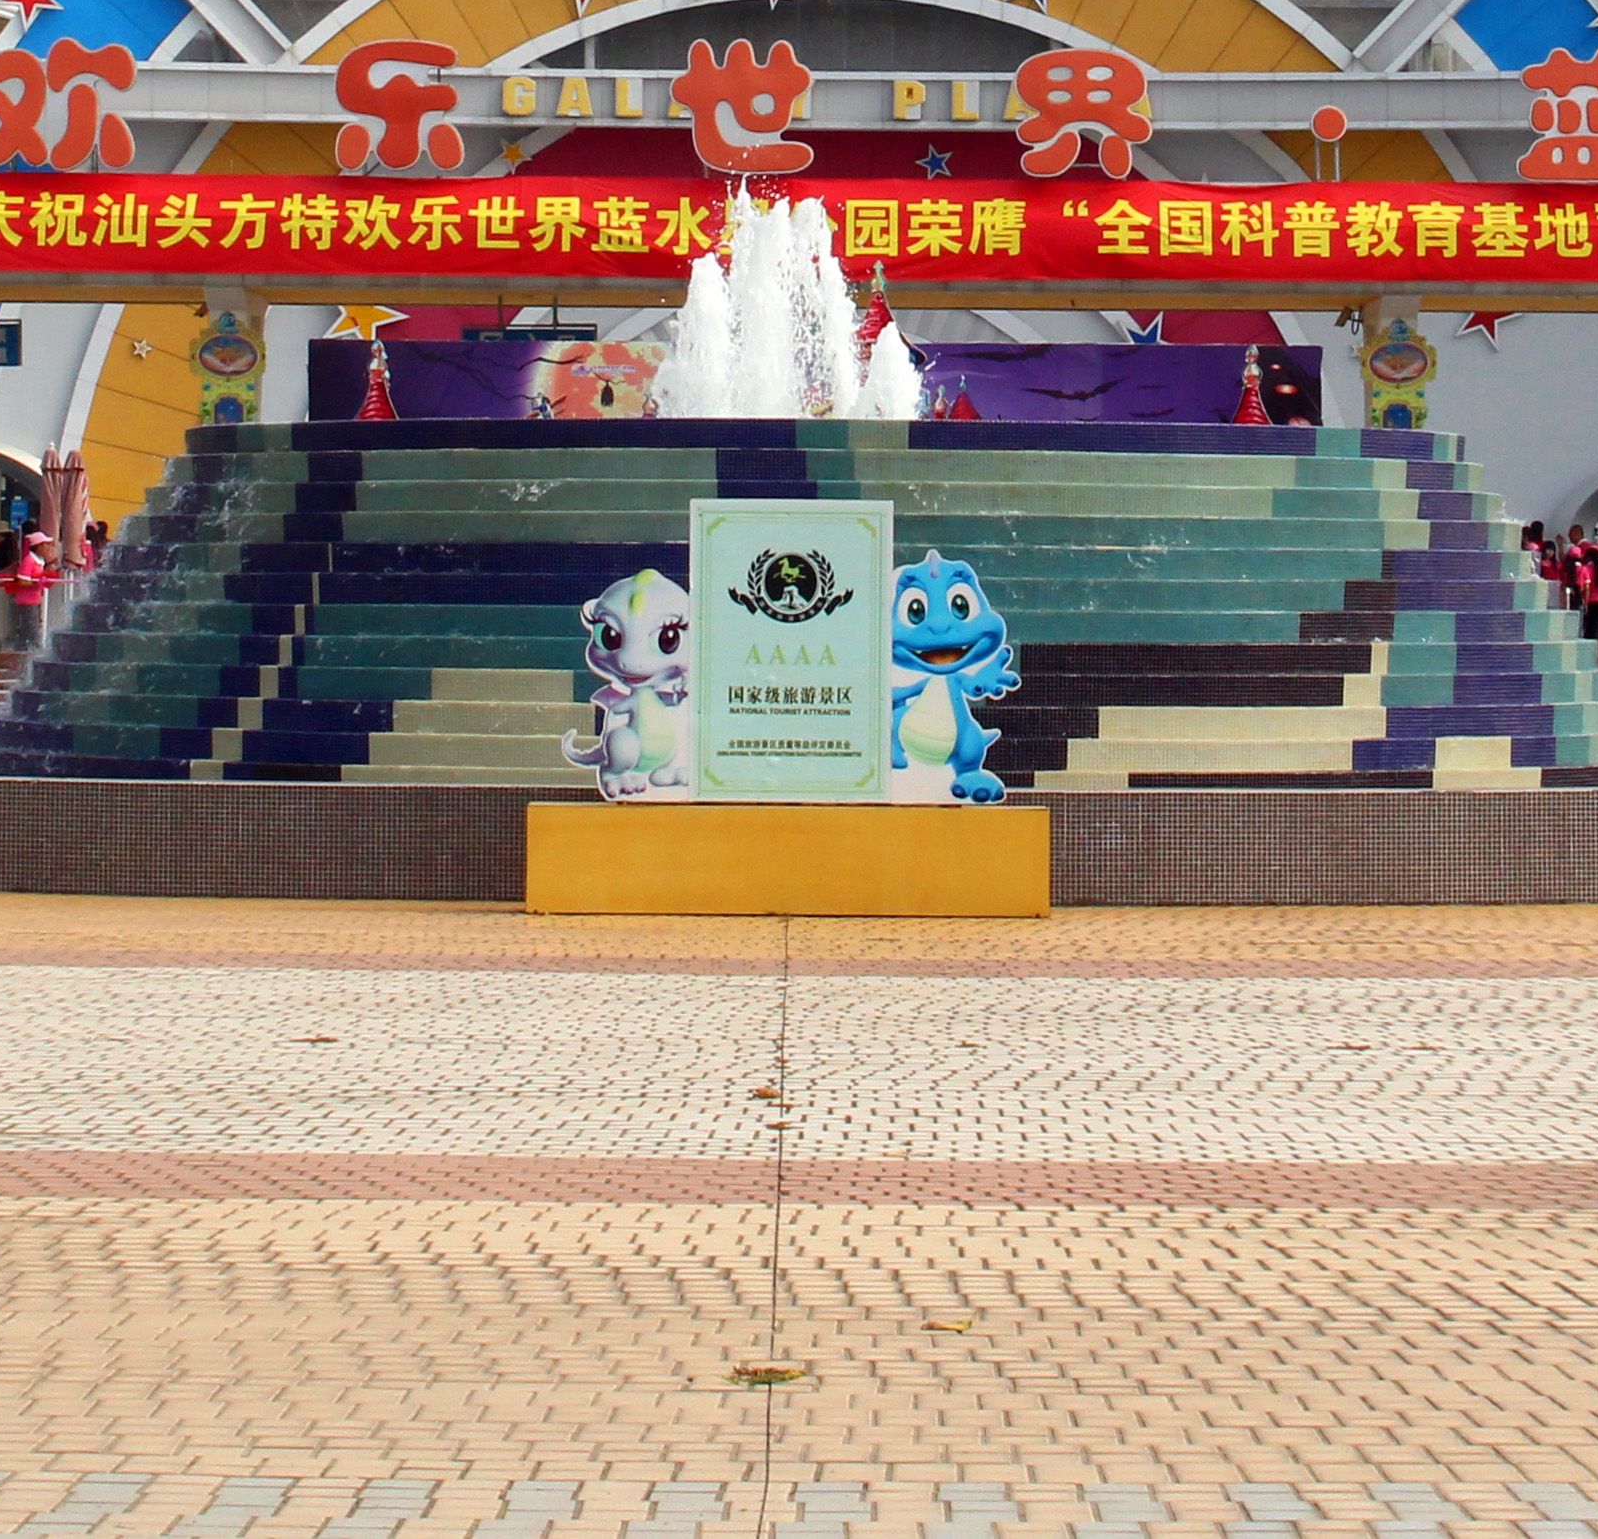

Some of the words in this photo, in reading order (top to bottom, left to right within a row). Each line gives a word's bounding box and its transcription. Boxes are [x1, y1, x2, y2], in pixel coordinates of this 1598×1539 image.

[502, 76, 811, 120] GAL
[728, 686, 851, 704] 国家级旅游景区
[730, 707, 768, 715] NATIONAL
[803, 708, 851, 716] ATTRACTION
